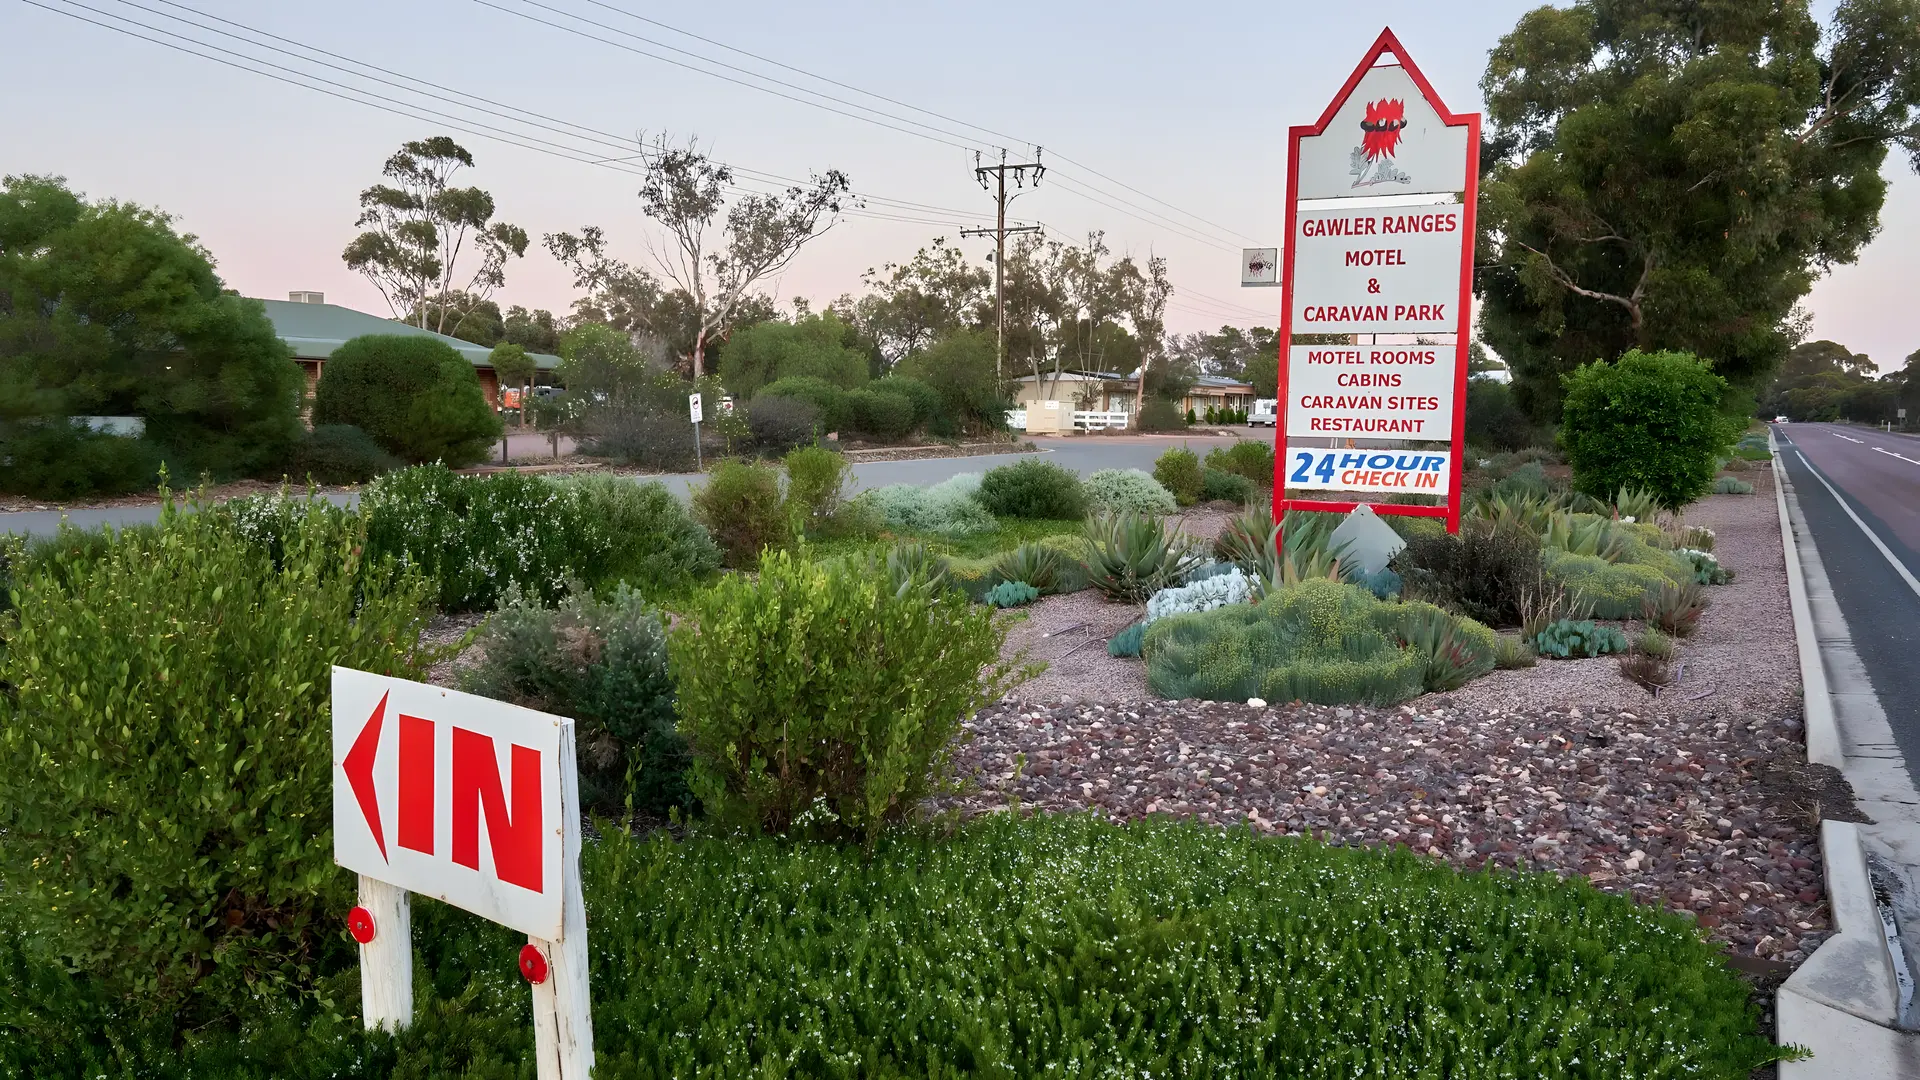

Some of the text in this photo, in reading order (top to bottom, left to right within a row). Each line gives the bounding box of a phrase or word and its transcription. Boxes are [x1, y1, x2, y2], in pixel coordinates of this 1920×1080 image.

[1303, 214, 1456, 237] GAWLER RANGES
[1345, 249, 1406, 267] MOTEL
[1367, 277, 1381, 294] &
[1304, 304, 1445, 323] CARAVAN PARK
[1308, 351, 1436, 365] MOTEL ROOMS
[1337, 373, 1402, 388] CABINS
[1301, 395, 1439, 411] CARAVAN SITES
[1311, 417, 1425, 433] RESTAURANT
[1290, 452, 1446, 484] 24 HOUR
[1341, 470, 1439, 488] CHECK IN
[397, 713, 544, 895] IN
